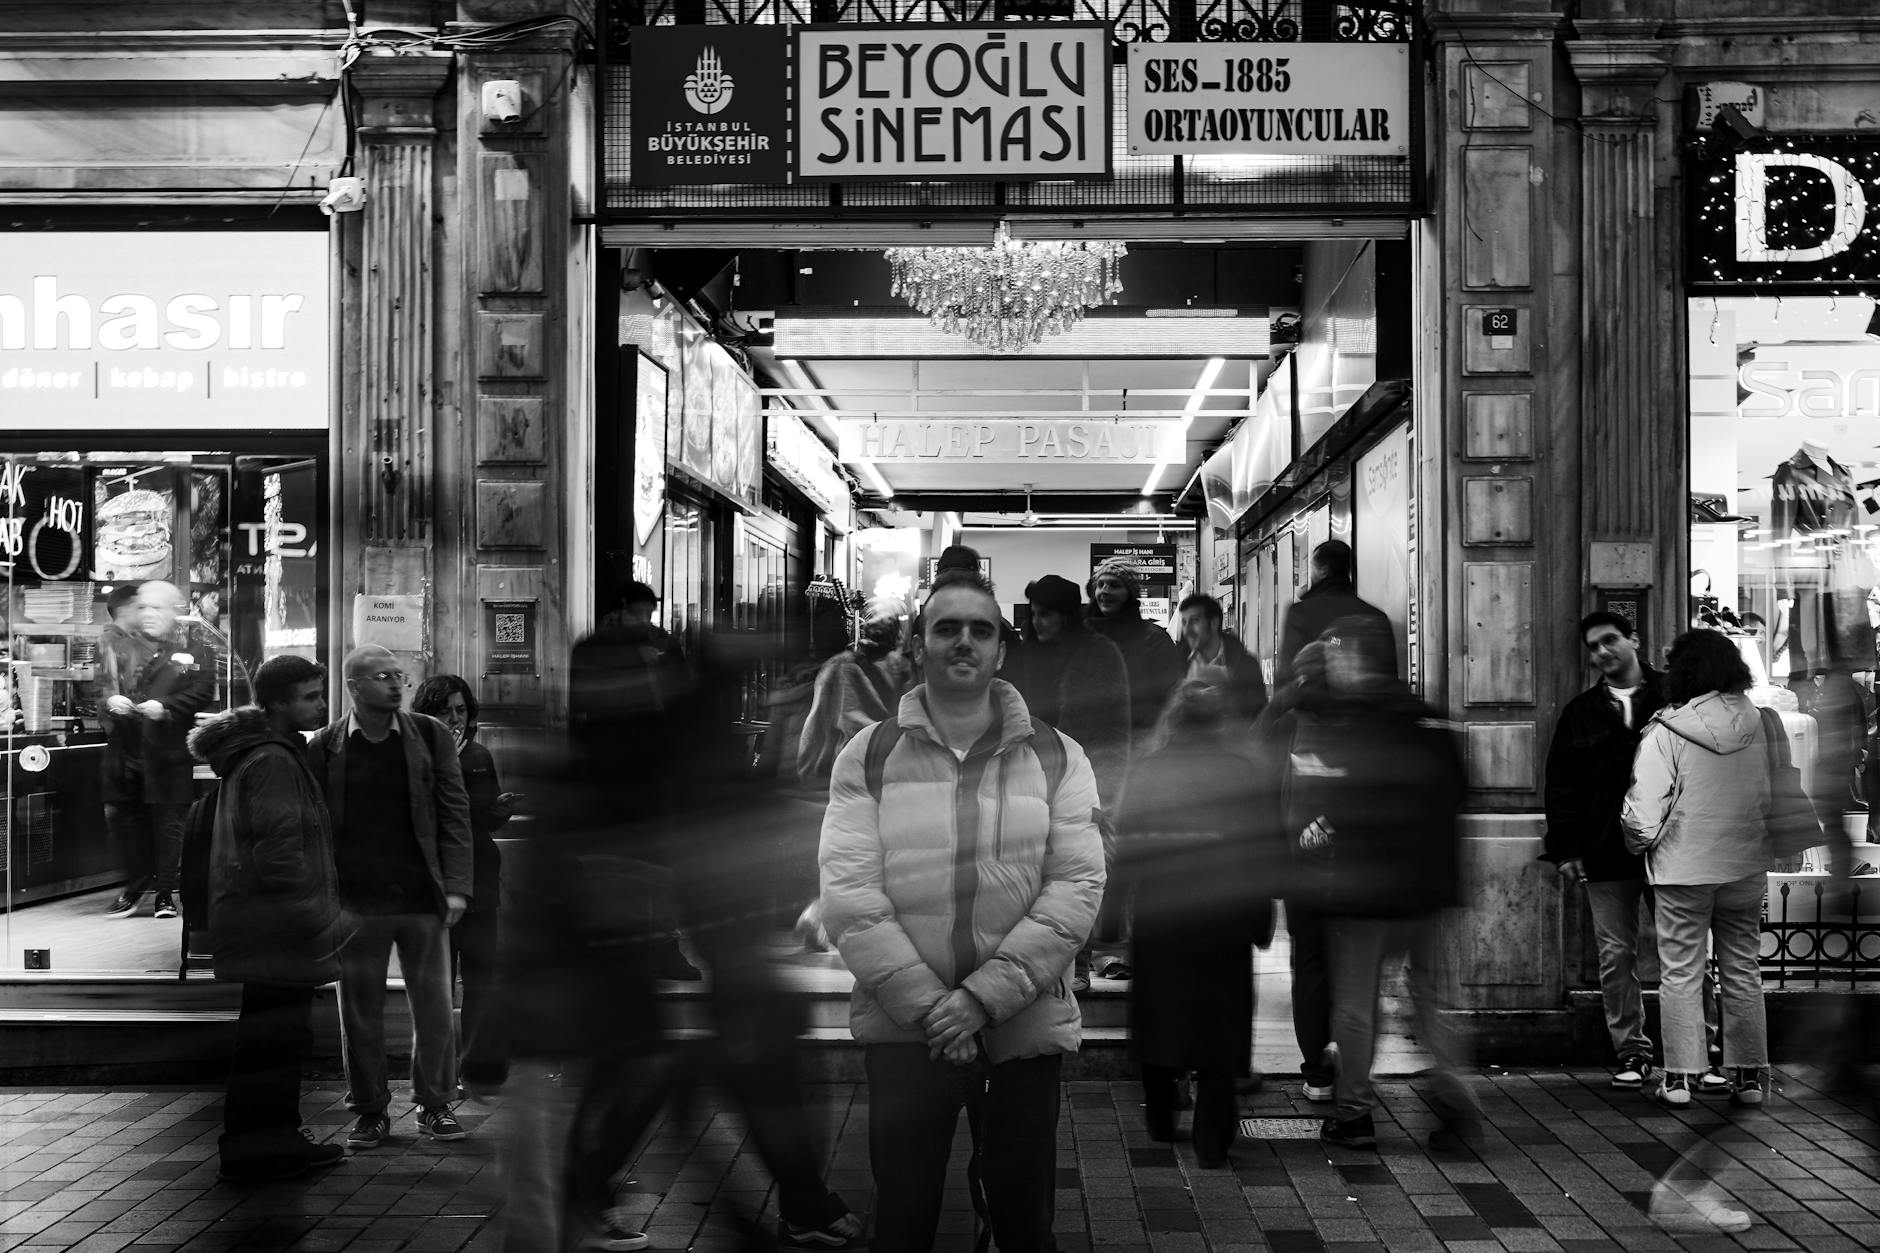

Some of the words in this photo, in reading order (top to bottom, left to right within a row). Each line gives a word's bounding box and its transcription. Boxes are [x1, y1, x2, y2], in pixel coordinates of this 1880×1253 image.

[818, 33, 1086, 98] BEYOĞLU
[667, 121, 751, 132] İSTANBUL
[1144, 108, 1391, 142] ORTAOYUNCULAR
[648, 133, 770, 153] BÜYÜKŞEHİR
[667, 154, 751, 165] BELEDİYESİ
[1735, 153, 1866, 262] D
[1492, 314, 1509, 329] 62
[2, 367, 82, 388] döner
[110, 367, 194, 392] kebap
[223, 367, 307, 388] bistro
[859, 423, 997, 458] HALEP
[1017, 423, 1159, 458] PASAJI
[49, 495, 83, 534] HOT
[1148, 558, 1166, 566] GİRİŞ
[373, 602, 395, 610] KOMİ
[366, 615, 405, 624] ARANIYOR
